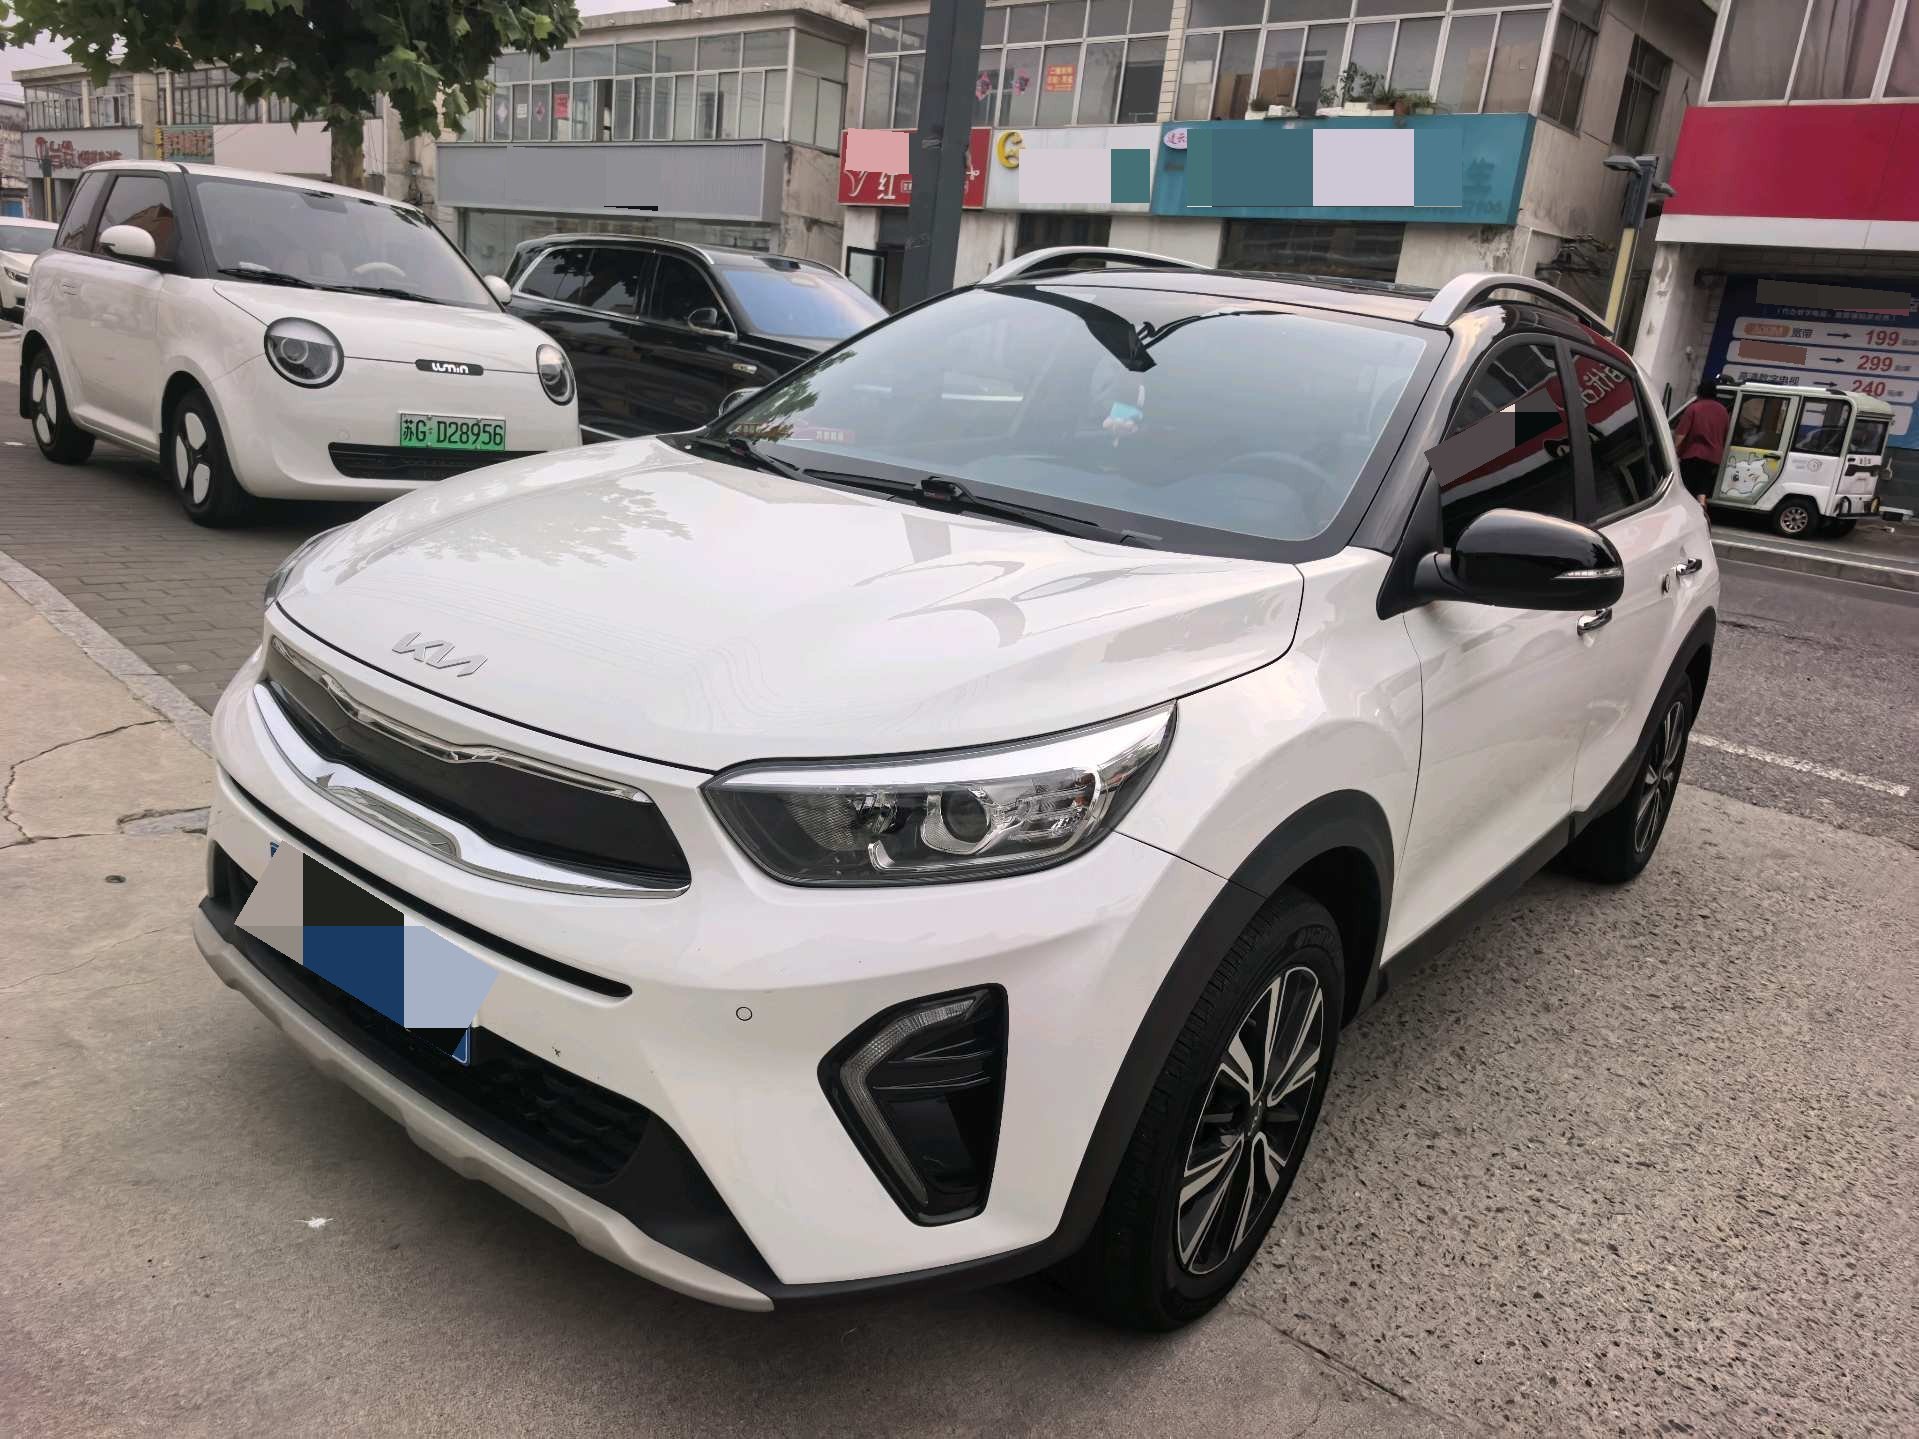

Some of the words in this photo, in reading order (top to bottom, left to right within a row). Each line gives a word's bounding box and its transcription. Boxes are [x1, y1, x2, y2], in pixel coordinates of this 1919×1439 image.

[1865, 329, 1900, 347] 199
[1856, 354, 1893, 372] 299
[1851, 379, 1886, 397] 240
